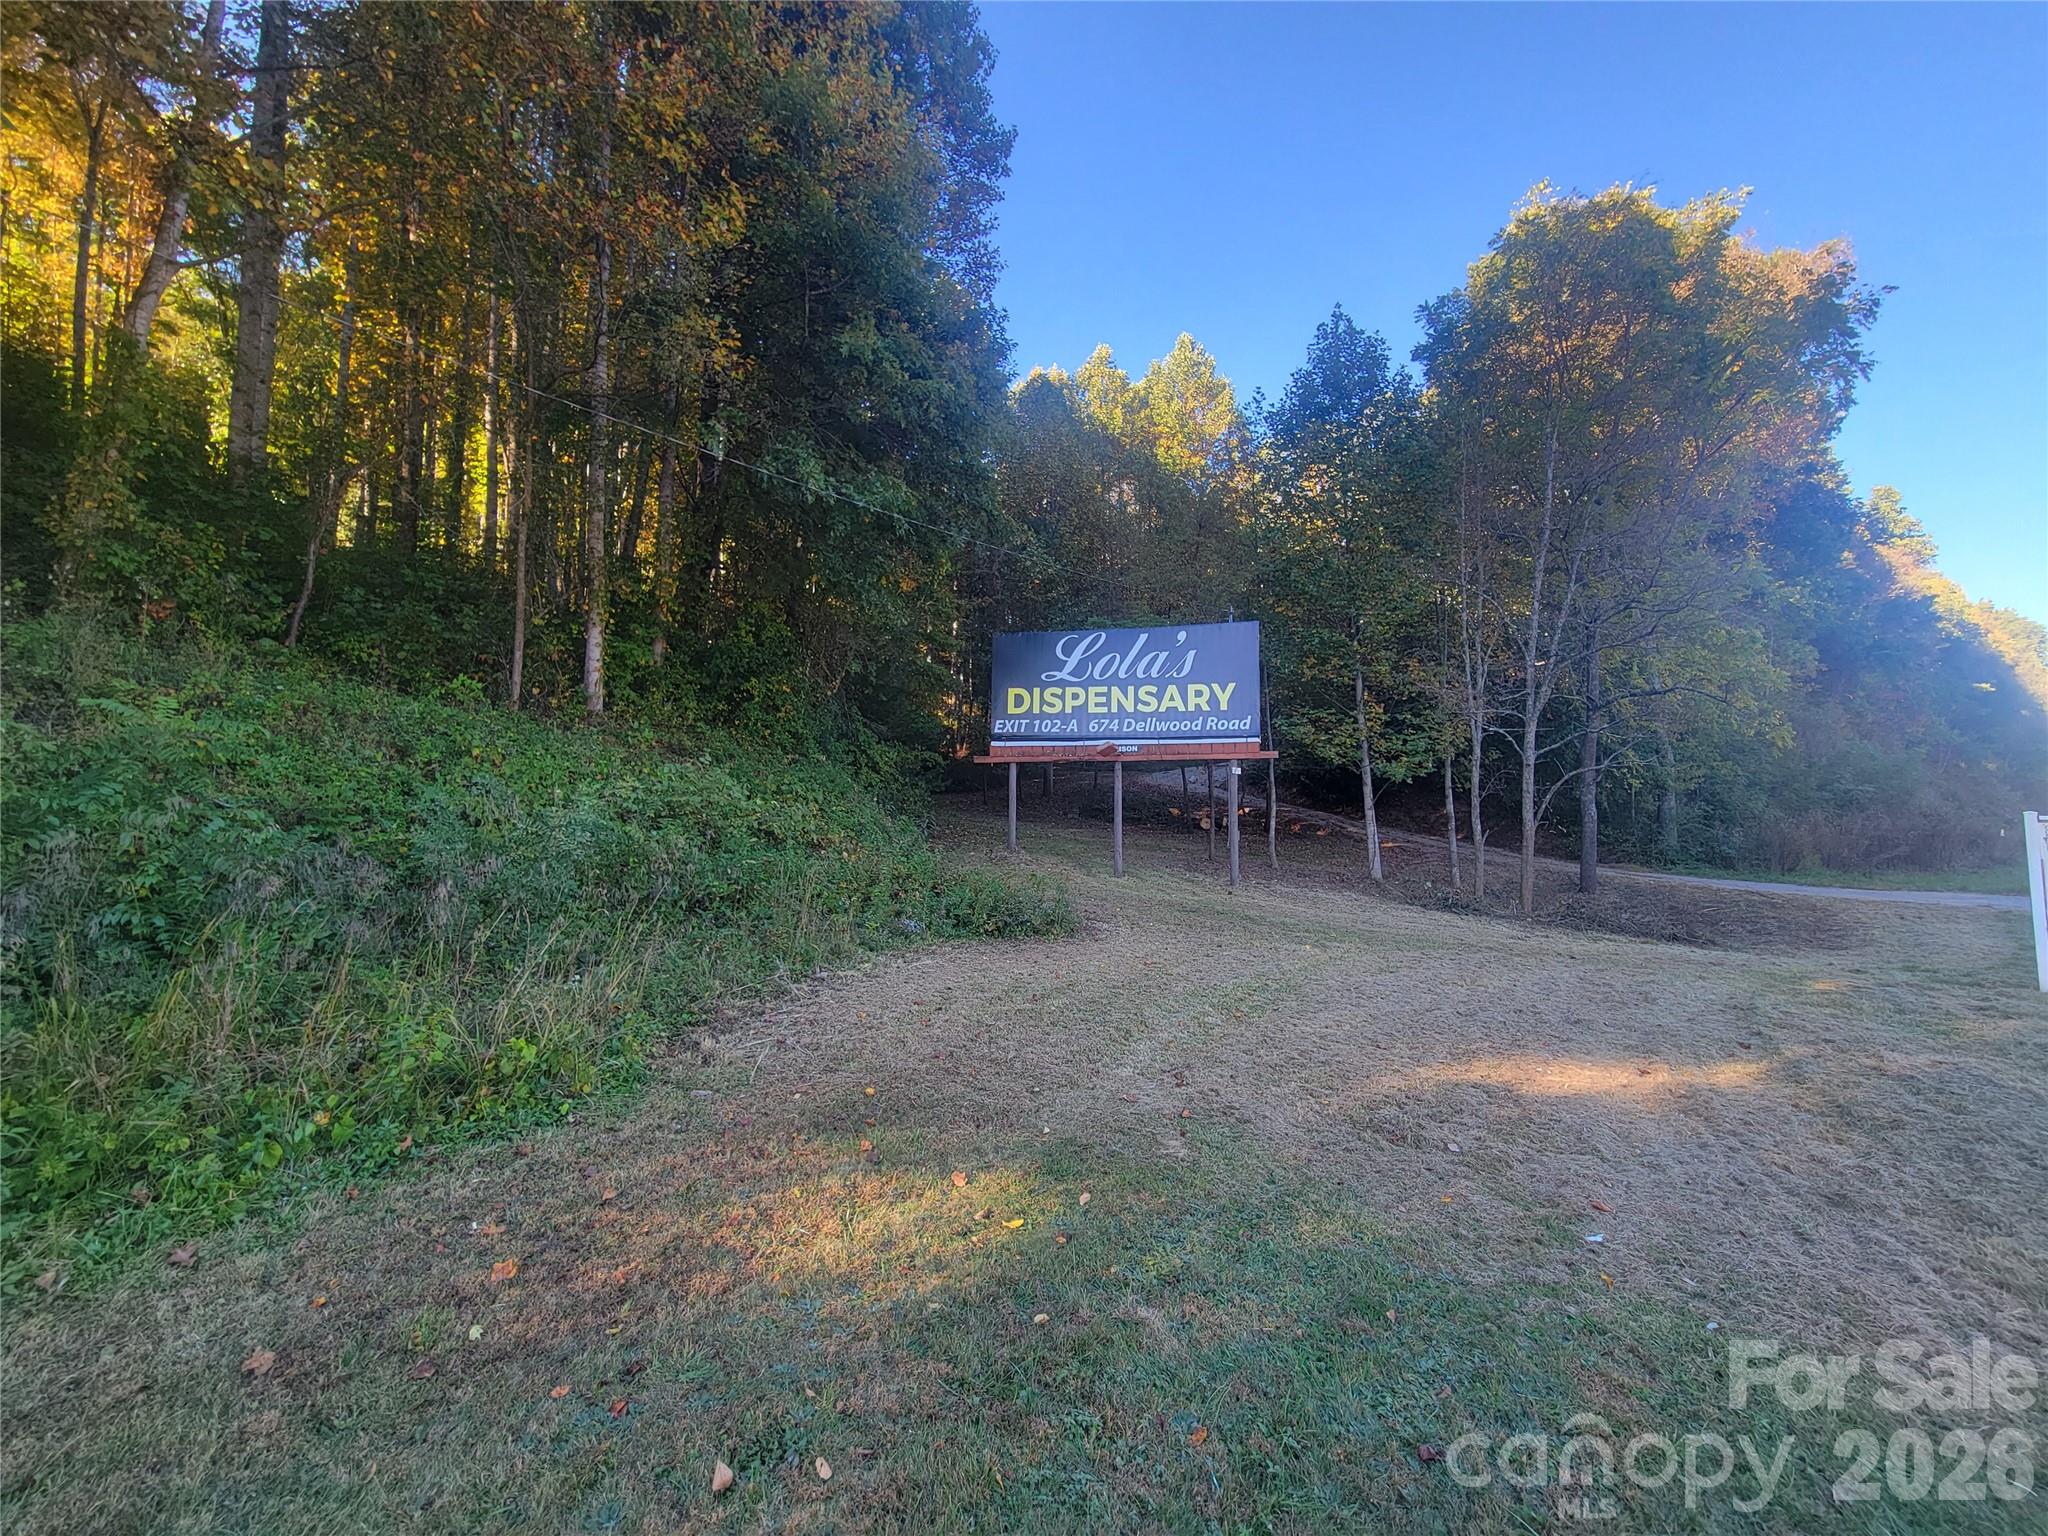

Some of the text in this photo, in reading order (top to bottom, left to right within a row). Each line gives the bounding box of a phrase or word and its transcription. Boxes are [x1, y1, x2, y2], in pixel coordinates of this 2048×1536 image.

[1041, 631, 1197, 682] Lola's
[1007, 682, 1236, 714] DISPENSARY
[994, 715, 1252, 733] EXIT 102-A 674 Dellwood Road
